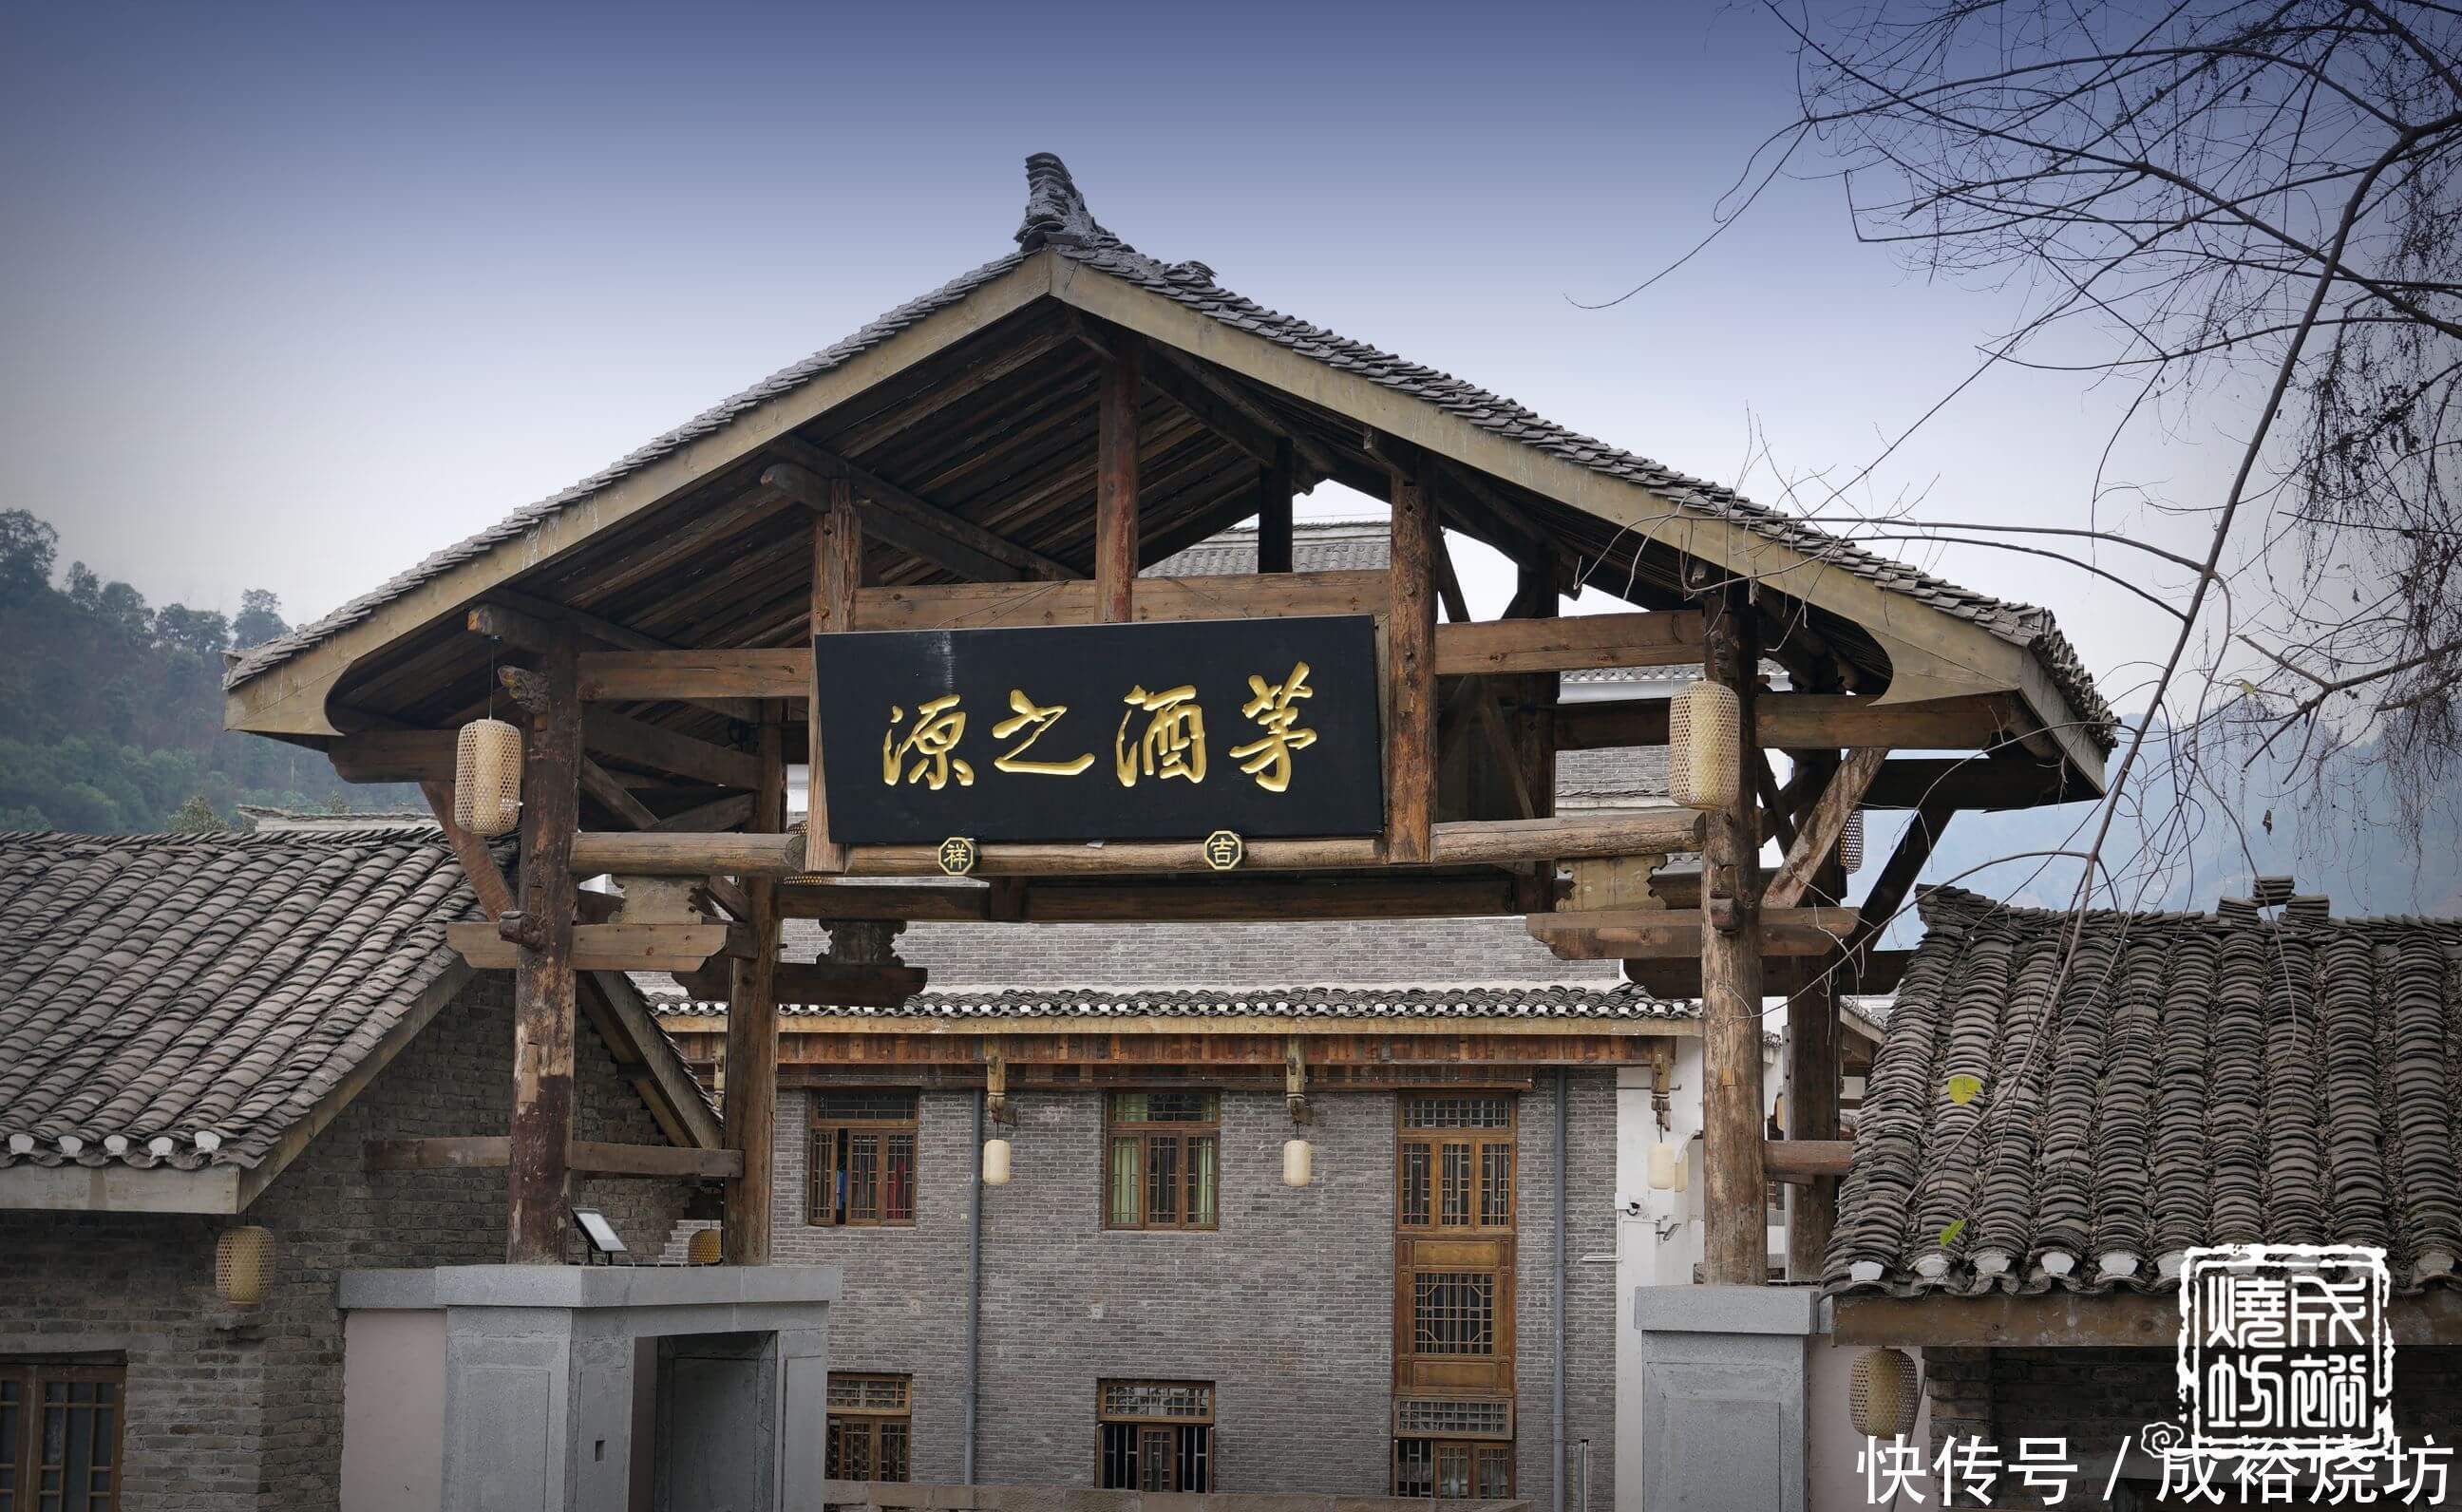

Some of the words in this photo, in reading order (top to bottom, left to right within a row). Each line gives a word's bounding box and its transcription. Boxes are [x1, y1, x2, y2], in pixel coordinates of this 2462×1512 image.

[882, 661, 1317, 792] 茅酒之源
[945, 844, 969, 868] 祥
[1210, 841, 1236, 865] 吉
